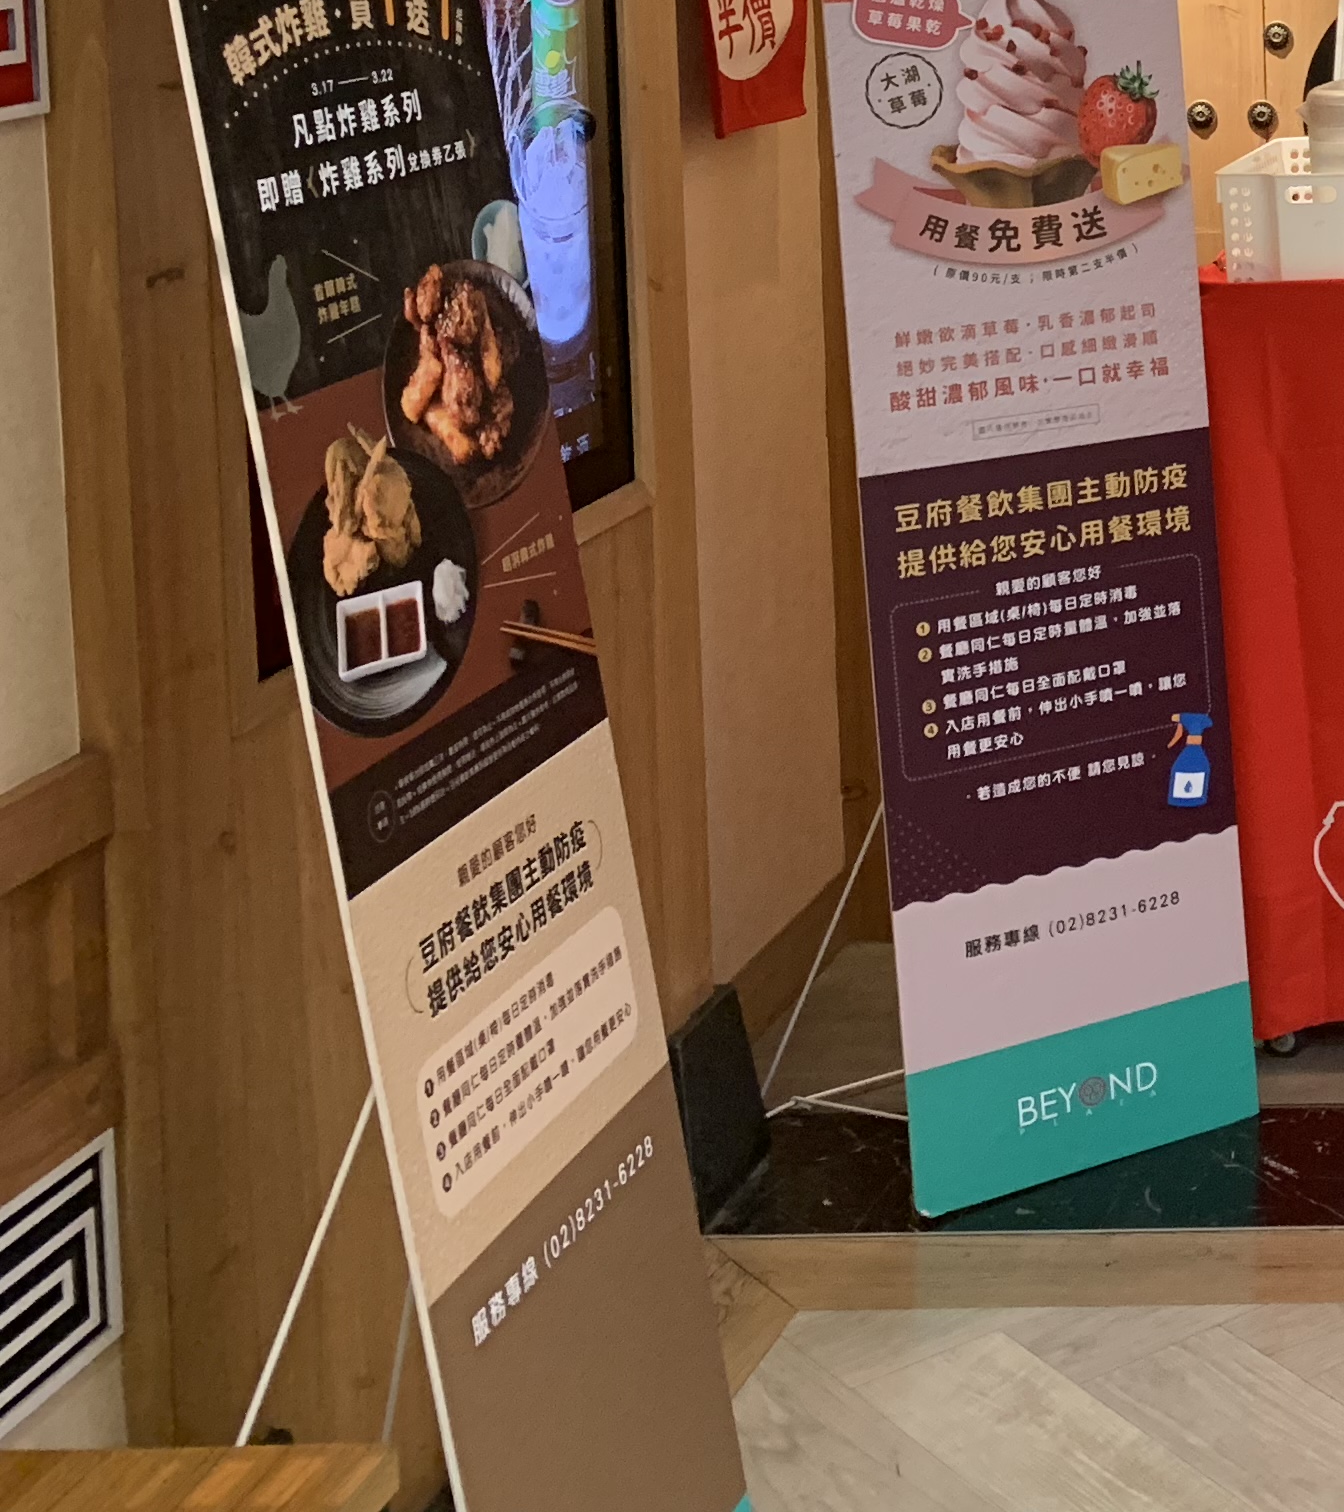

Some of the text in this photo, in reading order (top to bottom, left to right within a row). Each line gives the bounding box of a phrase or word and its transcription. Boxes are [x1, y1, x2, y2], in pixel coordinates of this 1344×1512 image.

[867, 9, 942, 37] 草莓果乾
[311, 68, 394, 97] 3.17 3.22
[880, 64, 921, 92] 大湖
[888, 88, 929, 115] 草莓
[292, 88, 423, 149] 凡點炸雞系列
[918, 205, 1108, 254] 用餐免費送
[895, 463, 1188, 533] 豆府餐飲集團主動防疫
[898, 506, 1191, 579] 提供給您安心用餐環境
[995, 565, 1102, 596] 親愛的顧客您好
[940, 656, 1019, 685] 實洗手措施
[942, 660, 1127, 710] 餐廳同仁每日全面配戴口罩
[947, 731, 1024, 760] 用餐更安心
[976, 751, 1145, 802] 若造成您的不便 請您見諒
[419, 820, 588, 974] 豆府餐飲集團主動防疫
[427, 860, 594, 1019] 提供給您安心用餐環境
[965, 891, 1181, 959] 服務專線 (02)8231-6228
[472, 1136, 653, 1347] 服務專線 (02)8231-6228
